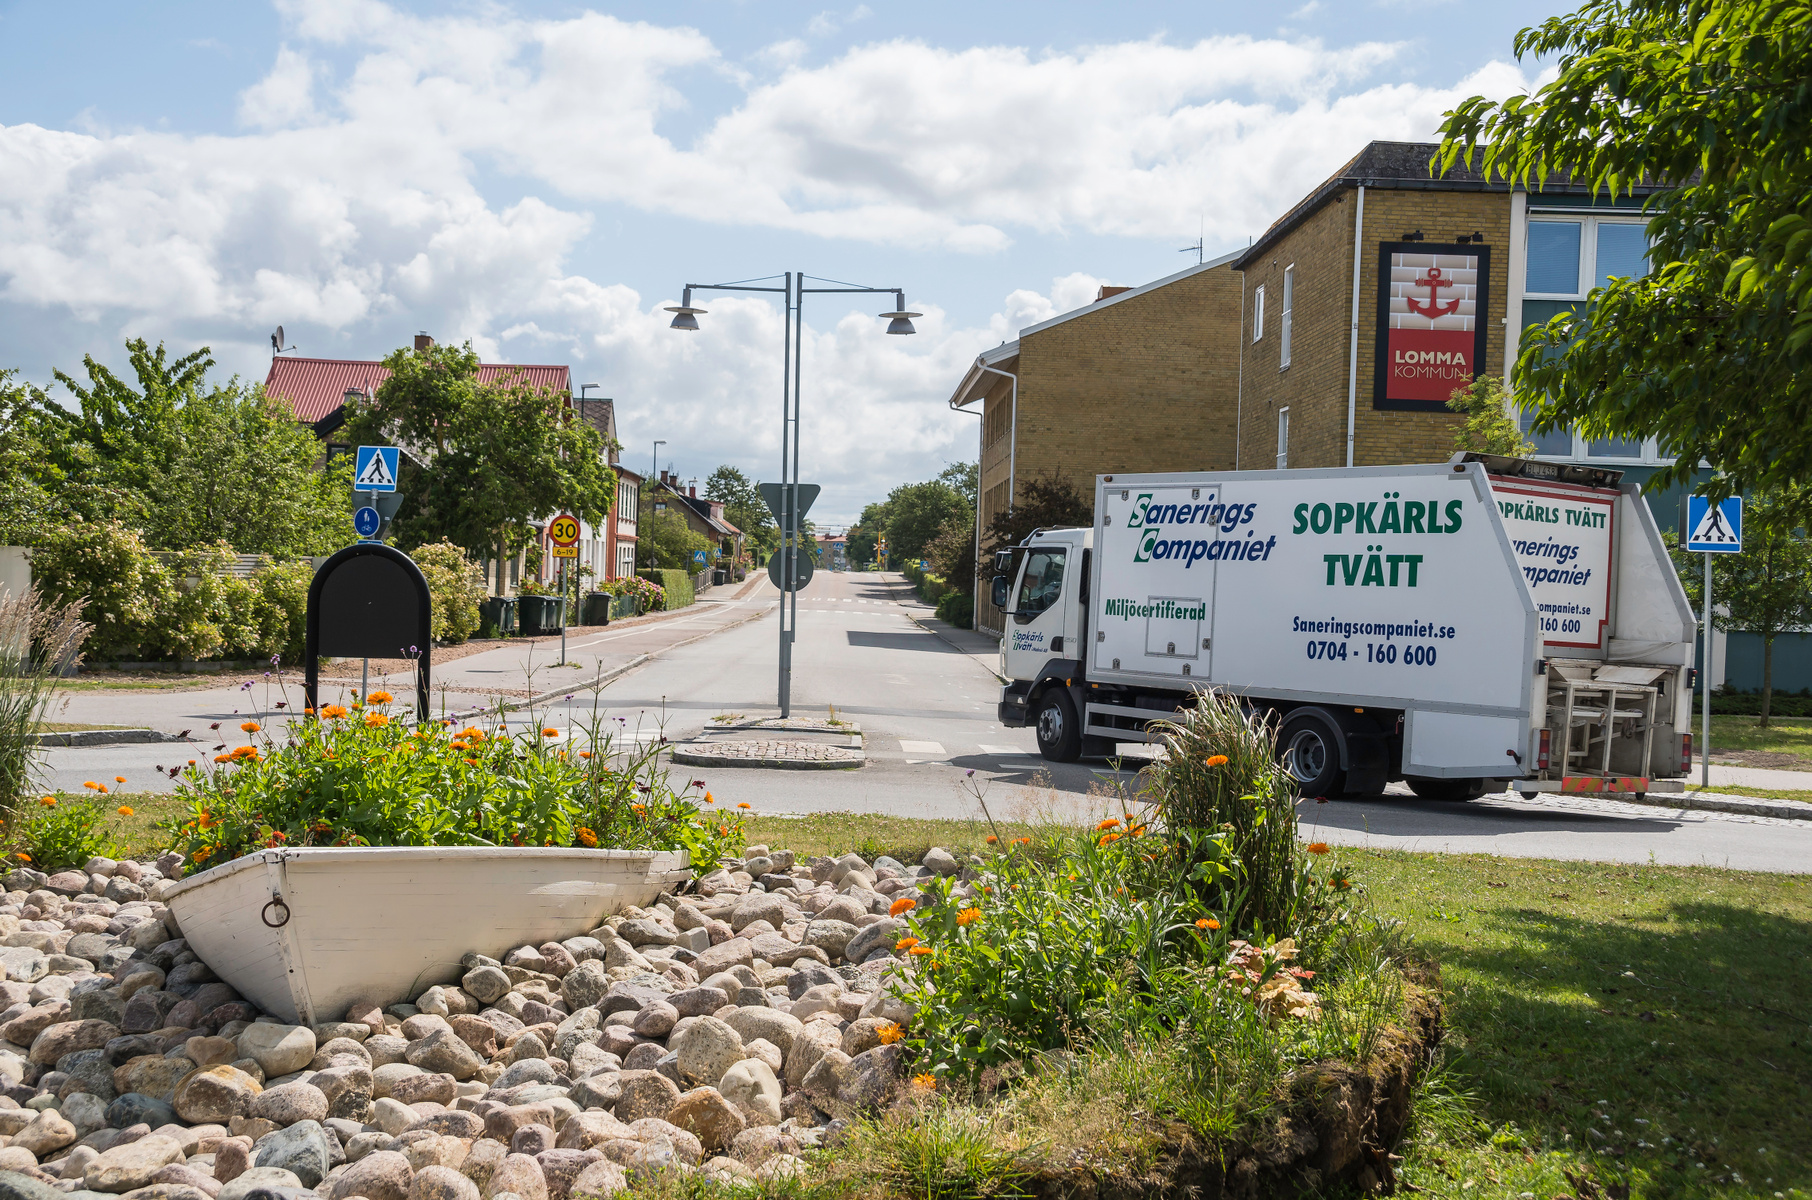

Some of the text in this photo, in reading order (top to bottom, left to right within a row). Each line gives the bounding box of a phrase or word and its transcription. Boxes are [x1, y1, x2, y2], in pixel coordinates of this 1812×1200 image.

[1395, 350, 1466, 365] LOMMA
[1394, 366, 1467, 379] KOMMUN
[1127, 493, 1257, 533] Sanerings
[1293, 492, 1462, 535] SOPKÄRLS
[1565, 507, 1606, 528] TVÄTT
[555, 523, 576, 538] 30
[1133, 528, 1276, 569] Companiet
[1512, 536, 1579, 564] nerings
[1323, 545, 1423, 587] TVÄTT
[1105, 598, 1206, 621] Miljöcertifierad
[1012, 629, 1044, 643] Sopkärls
[1293, 616, 1456, 641] Saneringscompaniet.se
[1540, 617, 1580, 633] 160 600
[1307, 640, 1347, 661] 0704
[1367, 643, 1397, 664] 160
[1403, 645, 1437, 666] 600
